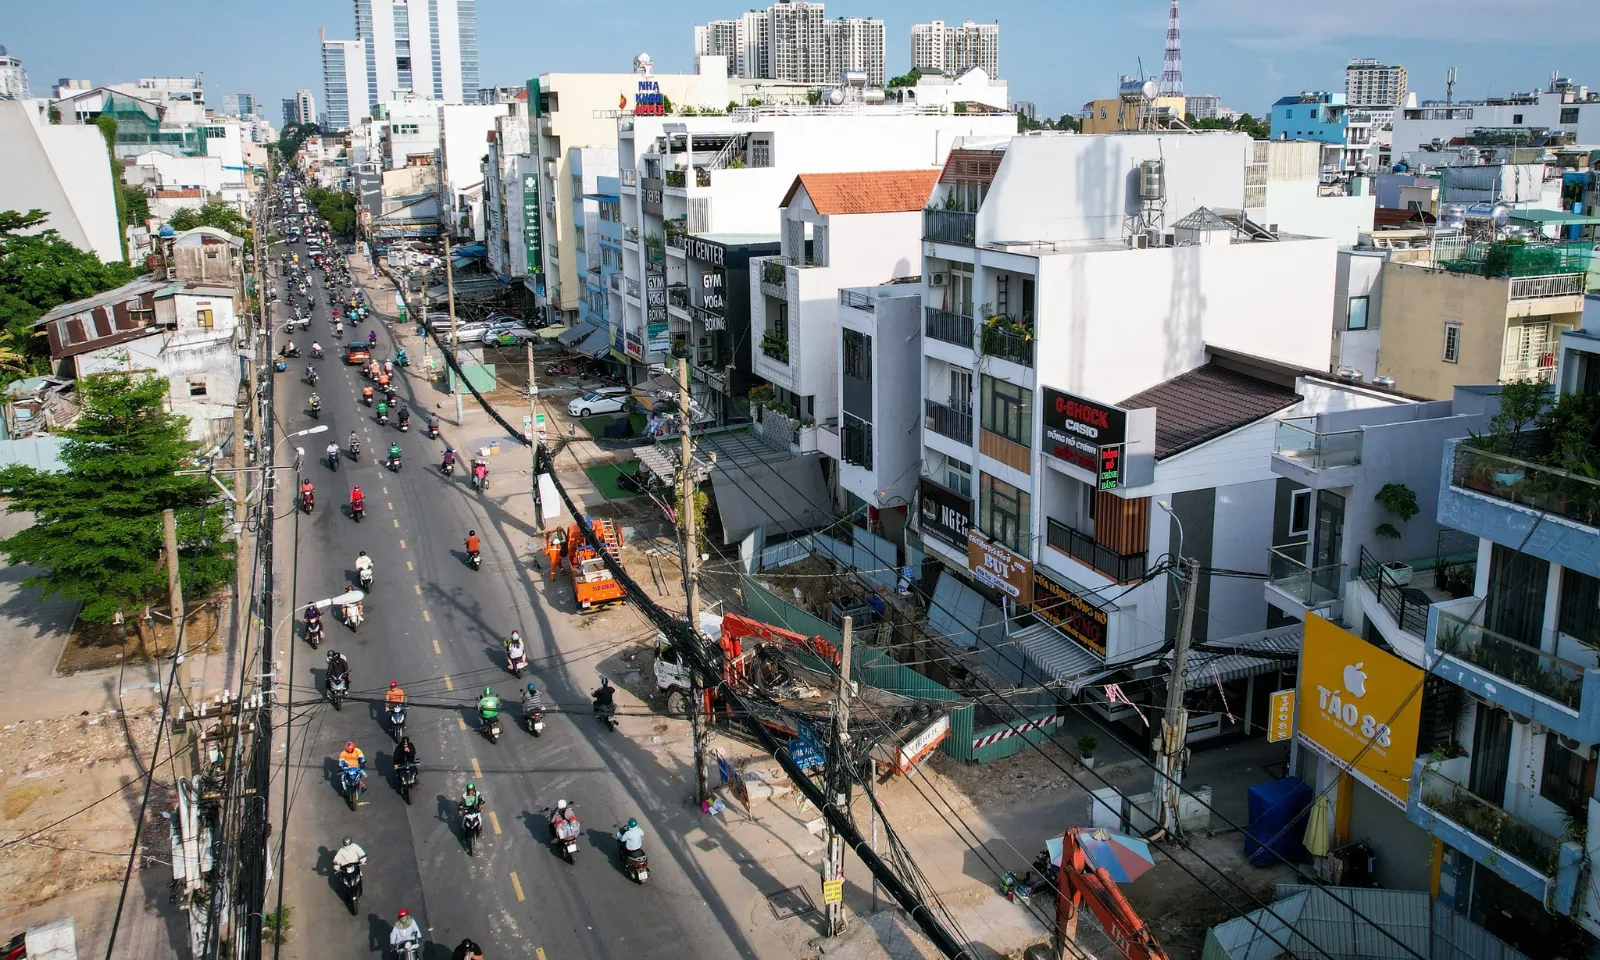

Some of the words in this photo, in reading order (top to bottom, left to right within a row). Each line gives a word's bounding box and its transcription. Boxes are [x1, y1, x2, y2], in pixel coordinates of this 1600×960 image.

[638, 81, 659, 92] NHA
[634, 104, 665, 115] APPLE
[685, 238, 695, 257] FIT
[695, 241, 724, 265] CENTER
[647, 276, 665, 288] GYM
[703, 274, 722, 288] GYM
[649, 291, 665, 305] YOGA
[704, 295, 724, 308] YOGA
[648, 309, 666, 320] BOXING
[704, 316, 726, 331] BOXING
[1055, 397, 1109, 428] G-SHOCK
[1065, 419, 1098, 438] CASIO
[1076, 443, 1097, 455] CHÍNH
[984, 553, 1009, 578] BỤI
[1316, 685, 1358, 726] TÁO
[1361, 714, 1391, 748] 88
